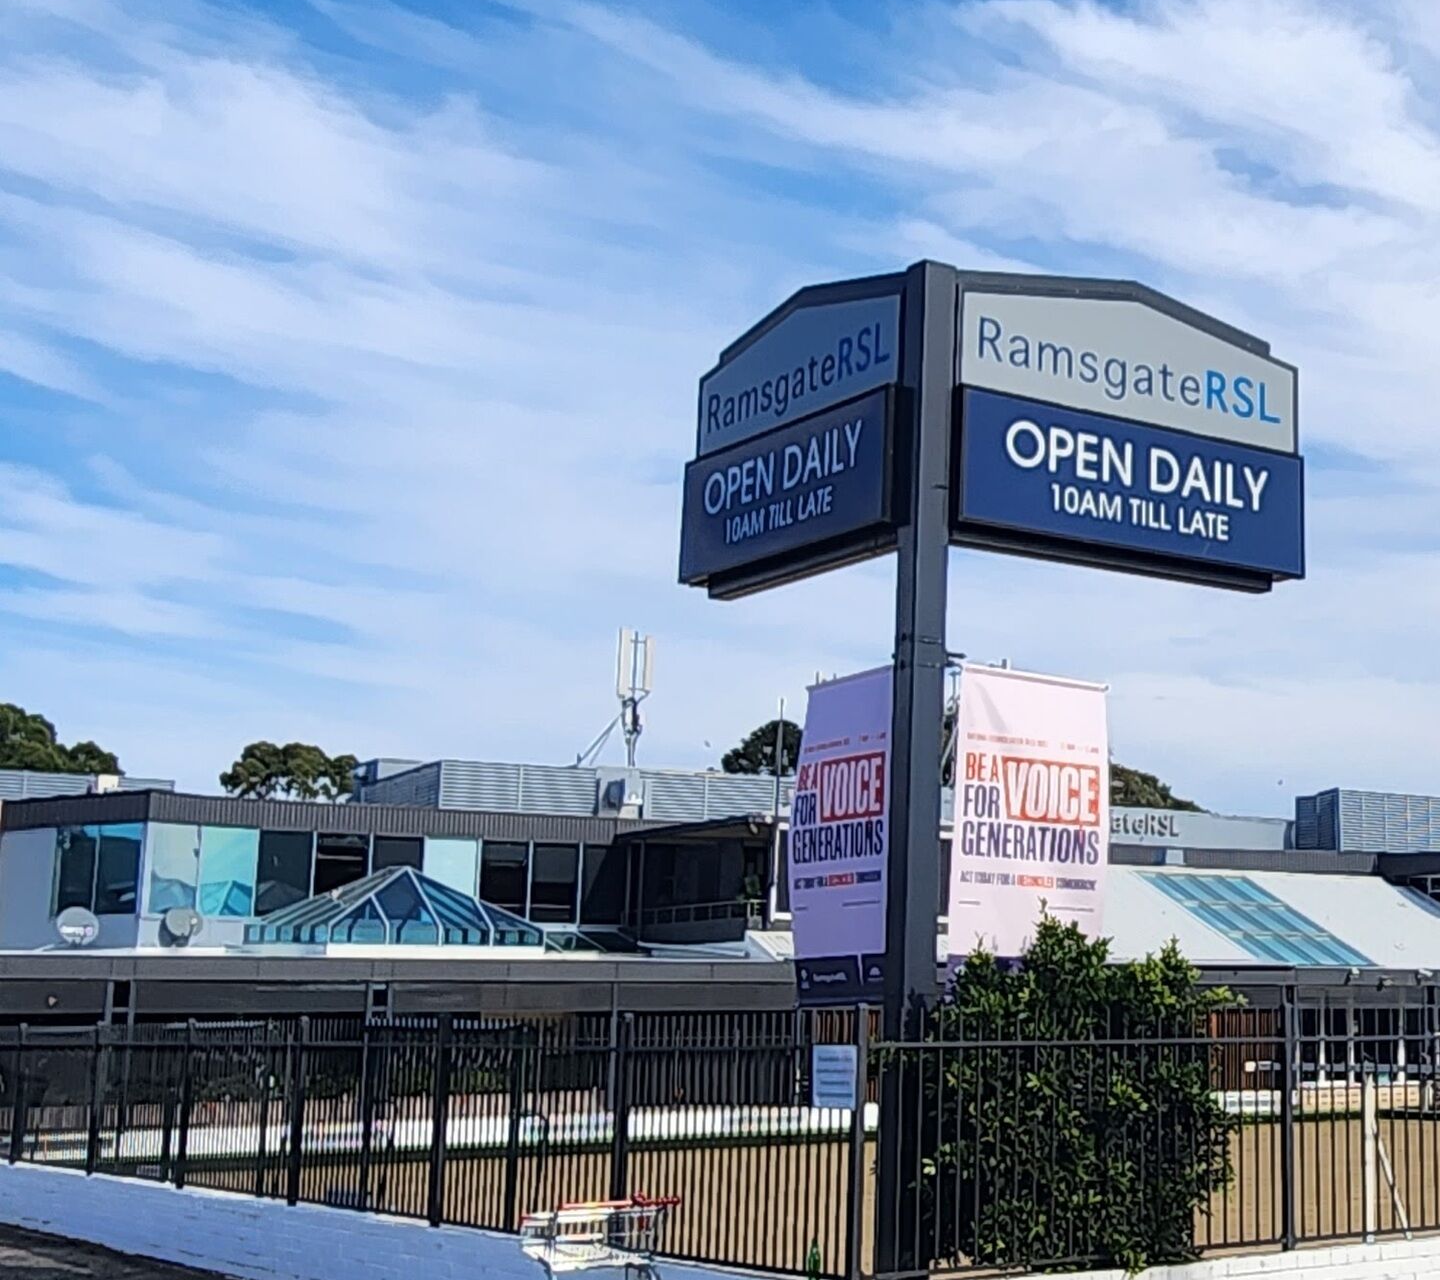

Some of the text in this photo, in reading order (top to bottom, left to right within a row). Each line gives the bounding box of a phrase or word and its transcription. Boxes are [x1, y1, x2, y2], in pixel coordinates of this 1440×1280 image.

[706, 322, 890, 434] RamsgateRSL
[977, 316, 1281, 424] RamsgateRSL
[704, 419, 863, 515] OPEN DAILY
[1005, 419, 1268, 512] OPEN DAILY
[726, 485, 833, 544] 10AM TILL LATE
[1050, 483, 1230, 542] 10AM TILL LATE
[793, 792, 817, 828] FOR
[823, 756, 882, 818] VOICE
[963, 784, 1000, 819] FOR
[965, 752, 1097, 822] BE A VOICE
[792, 819, 884, 864] GENERATIONS
[961, 820, 1099, 866] GENERATIONS
